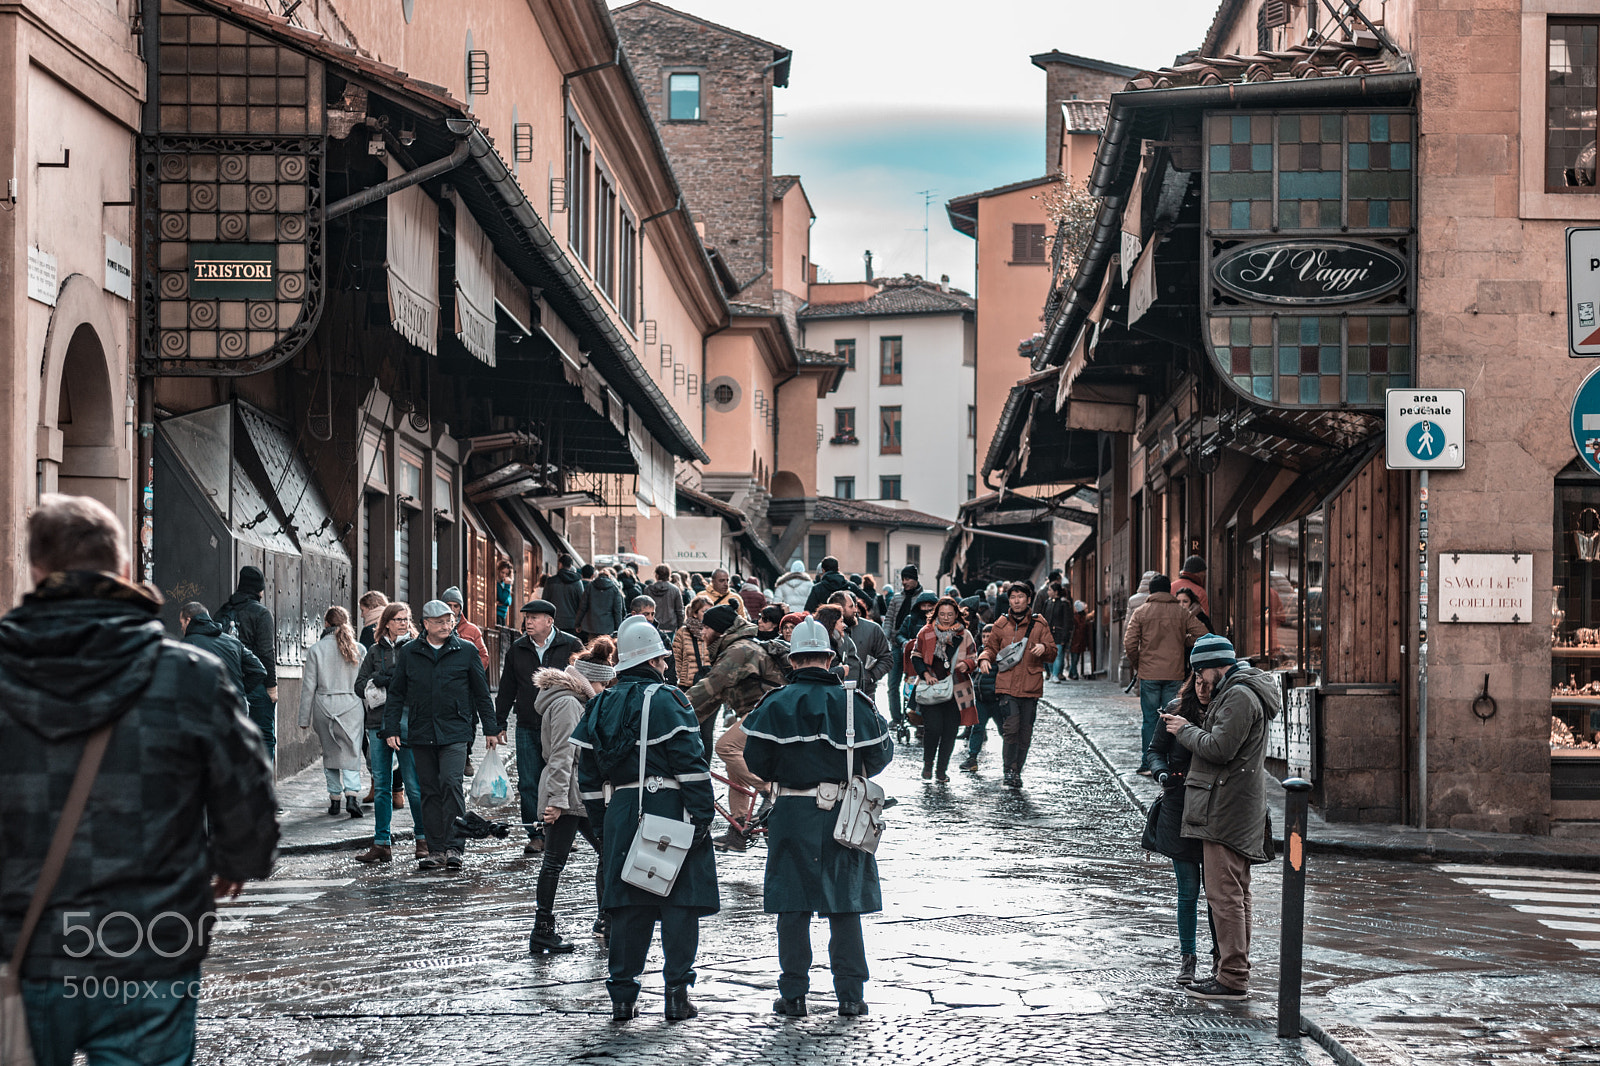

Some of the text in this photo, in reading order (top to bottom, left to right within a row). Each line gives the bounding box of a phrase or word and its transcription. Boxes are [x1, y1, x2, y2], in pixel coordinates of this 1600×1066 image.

[194, 263, 272, 278] T.RISTORI
[1240, 248, 1374, 292] S. Vaggi
[677, 551, 708, 559] ROLEX
